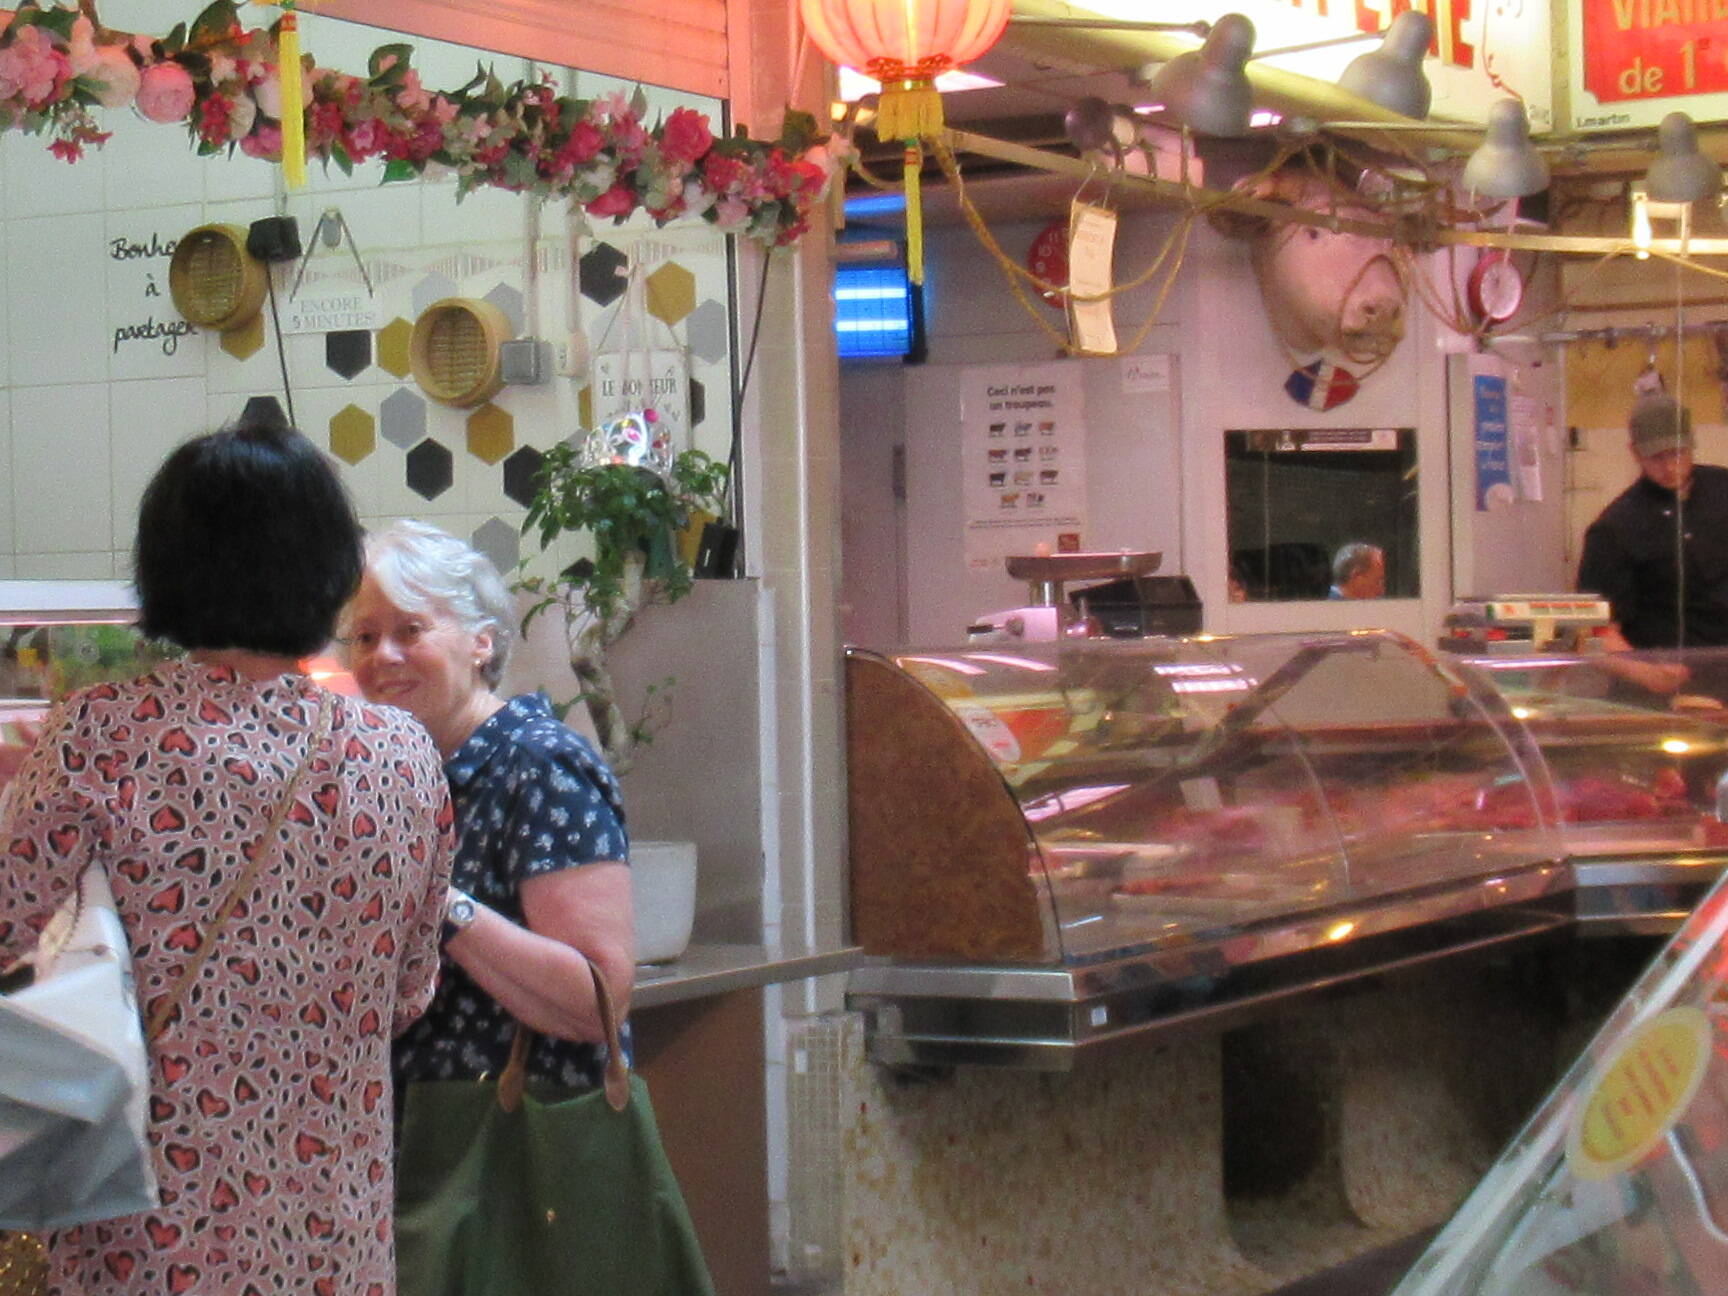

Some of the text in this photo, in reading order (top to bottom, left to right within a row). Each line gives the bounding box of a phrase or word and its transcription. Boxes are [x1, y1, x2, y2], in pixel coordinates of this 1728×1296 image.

[1619, 56, 1664, 95] de
[110, 232, 177, 261] Bonhe
[145, 272, 160, 297] à
[300, 296, 363, 313] ENCORE
[292, 316, 301, 330] 5
[113, 315, 198, 356] partager
[602, 379, 615, 397] LE
[986, 386, 1009, 397] Ceci
